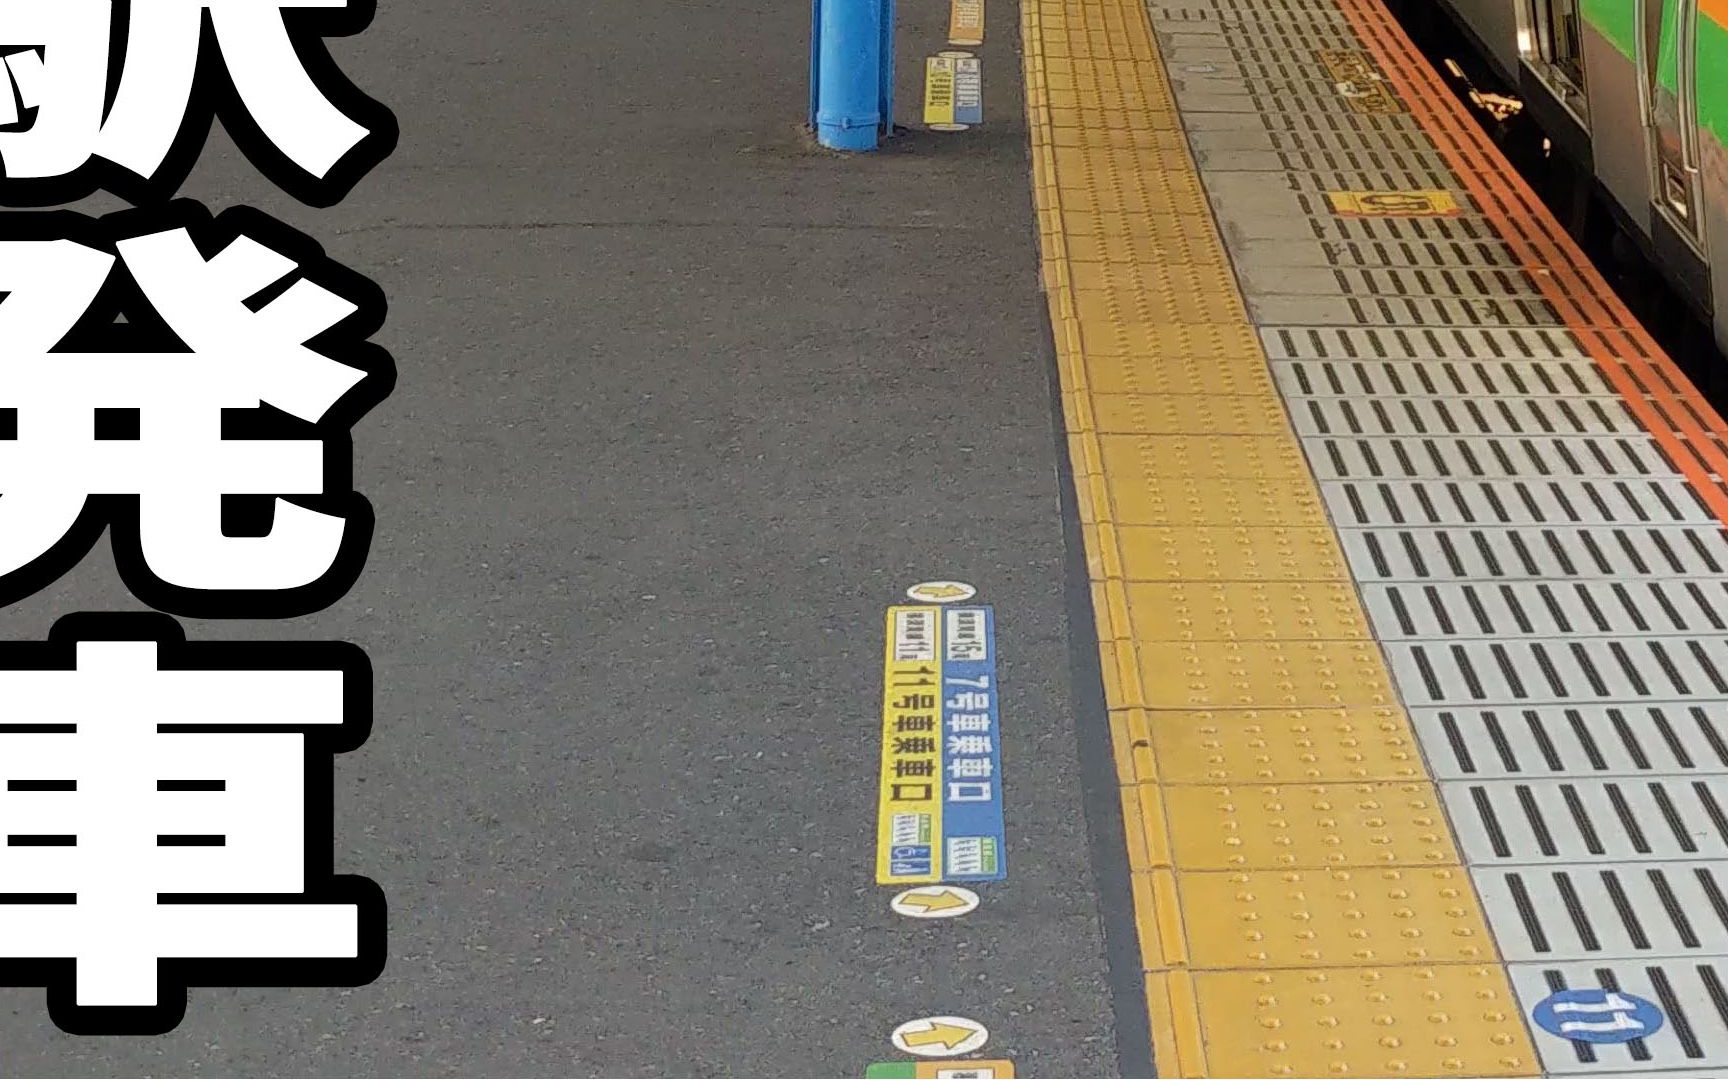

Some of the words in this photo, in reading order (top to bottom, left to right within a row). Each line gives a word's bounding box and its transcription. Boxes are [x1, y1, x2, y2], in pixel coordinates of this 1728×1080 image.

[890, 664, 937, 802] 11号車乗車口
[945, 674, 993, 803] 7号車乗車口
